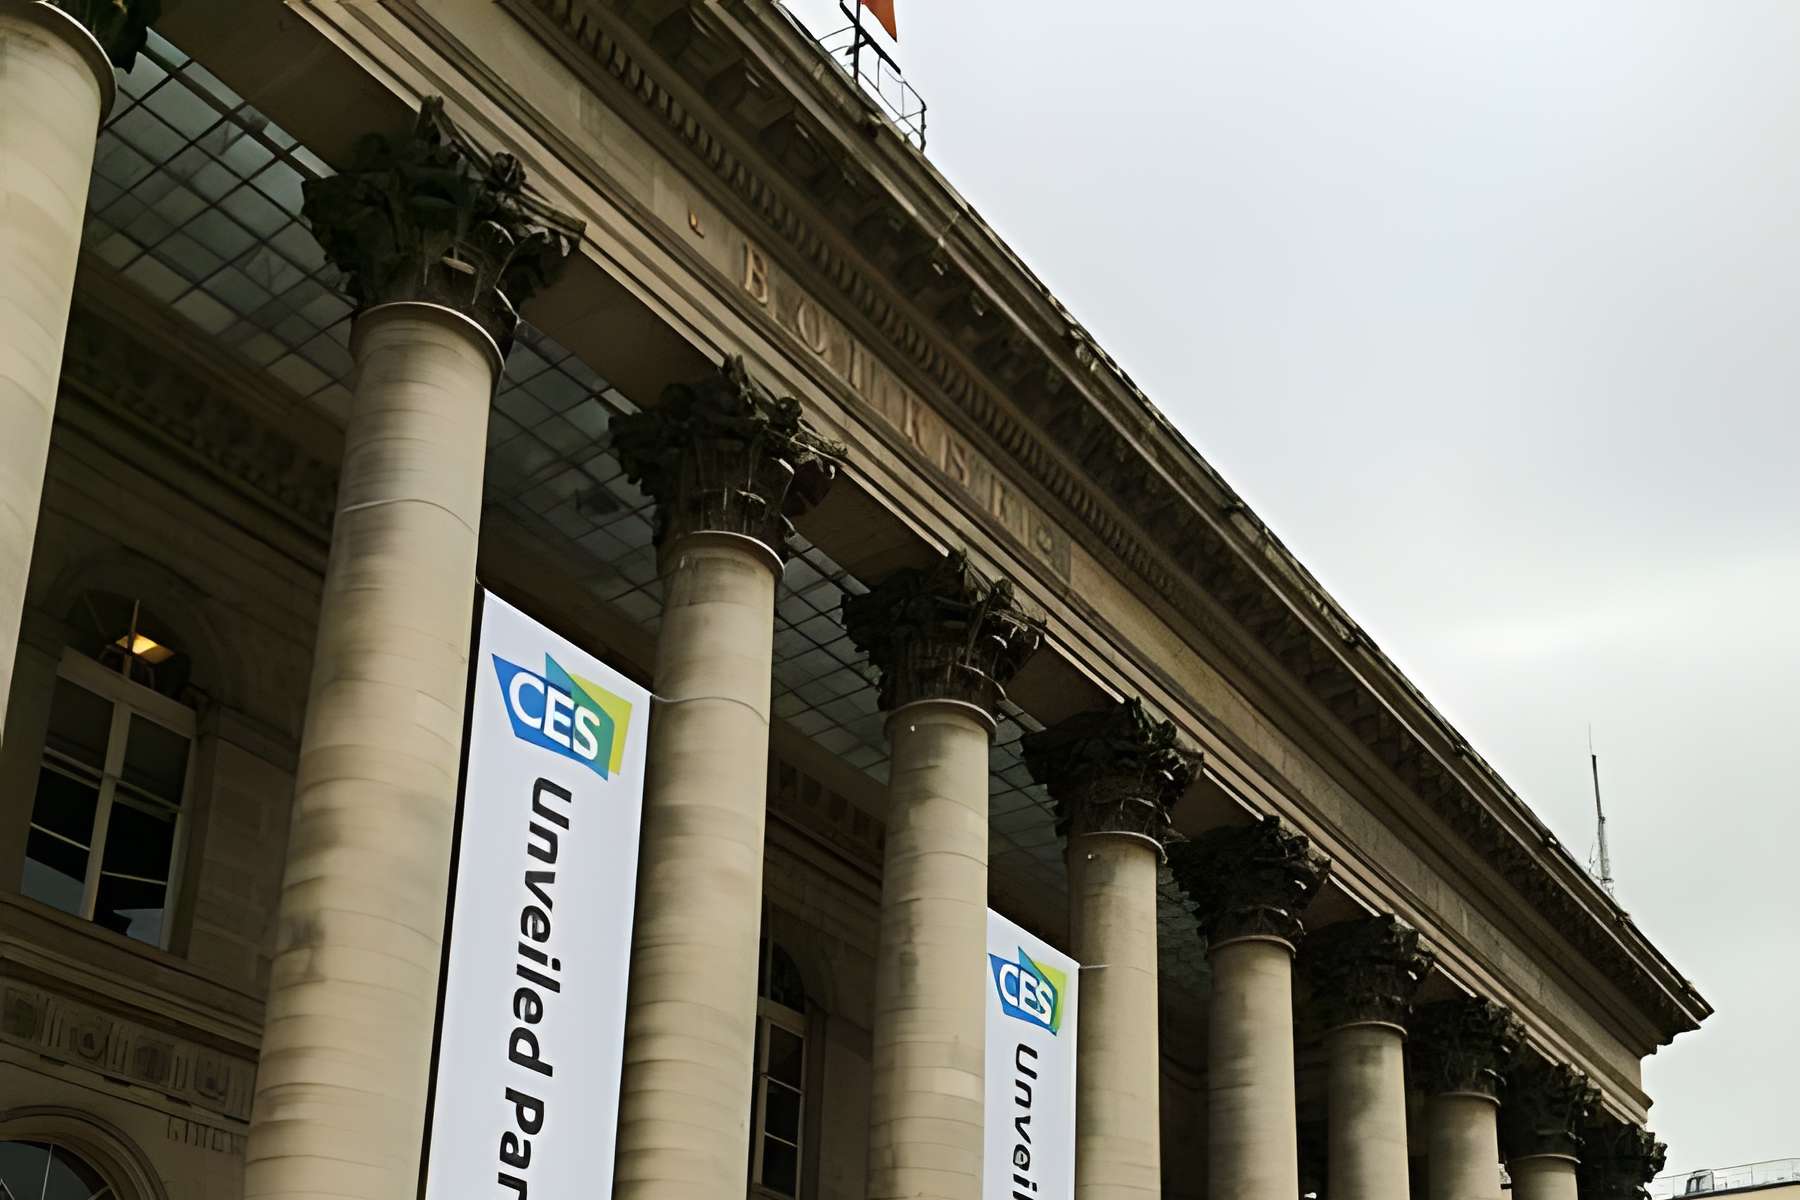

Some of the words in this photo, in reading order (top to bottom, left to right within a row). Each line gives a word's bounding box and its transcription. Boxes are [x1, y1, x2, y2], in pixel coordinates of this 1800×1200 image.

[509, 672, 600, 760] CES
[508, 777, 573, 1078] Unveiled
[999, 963, 1053, 1025] CES
